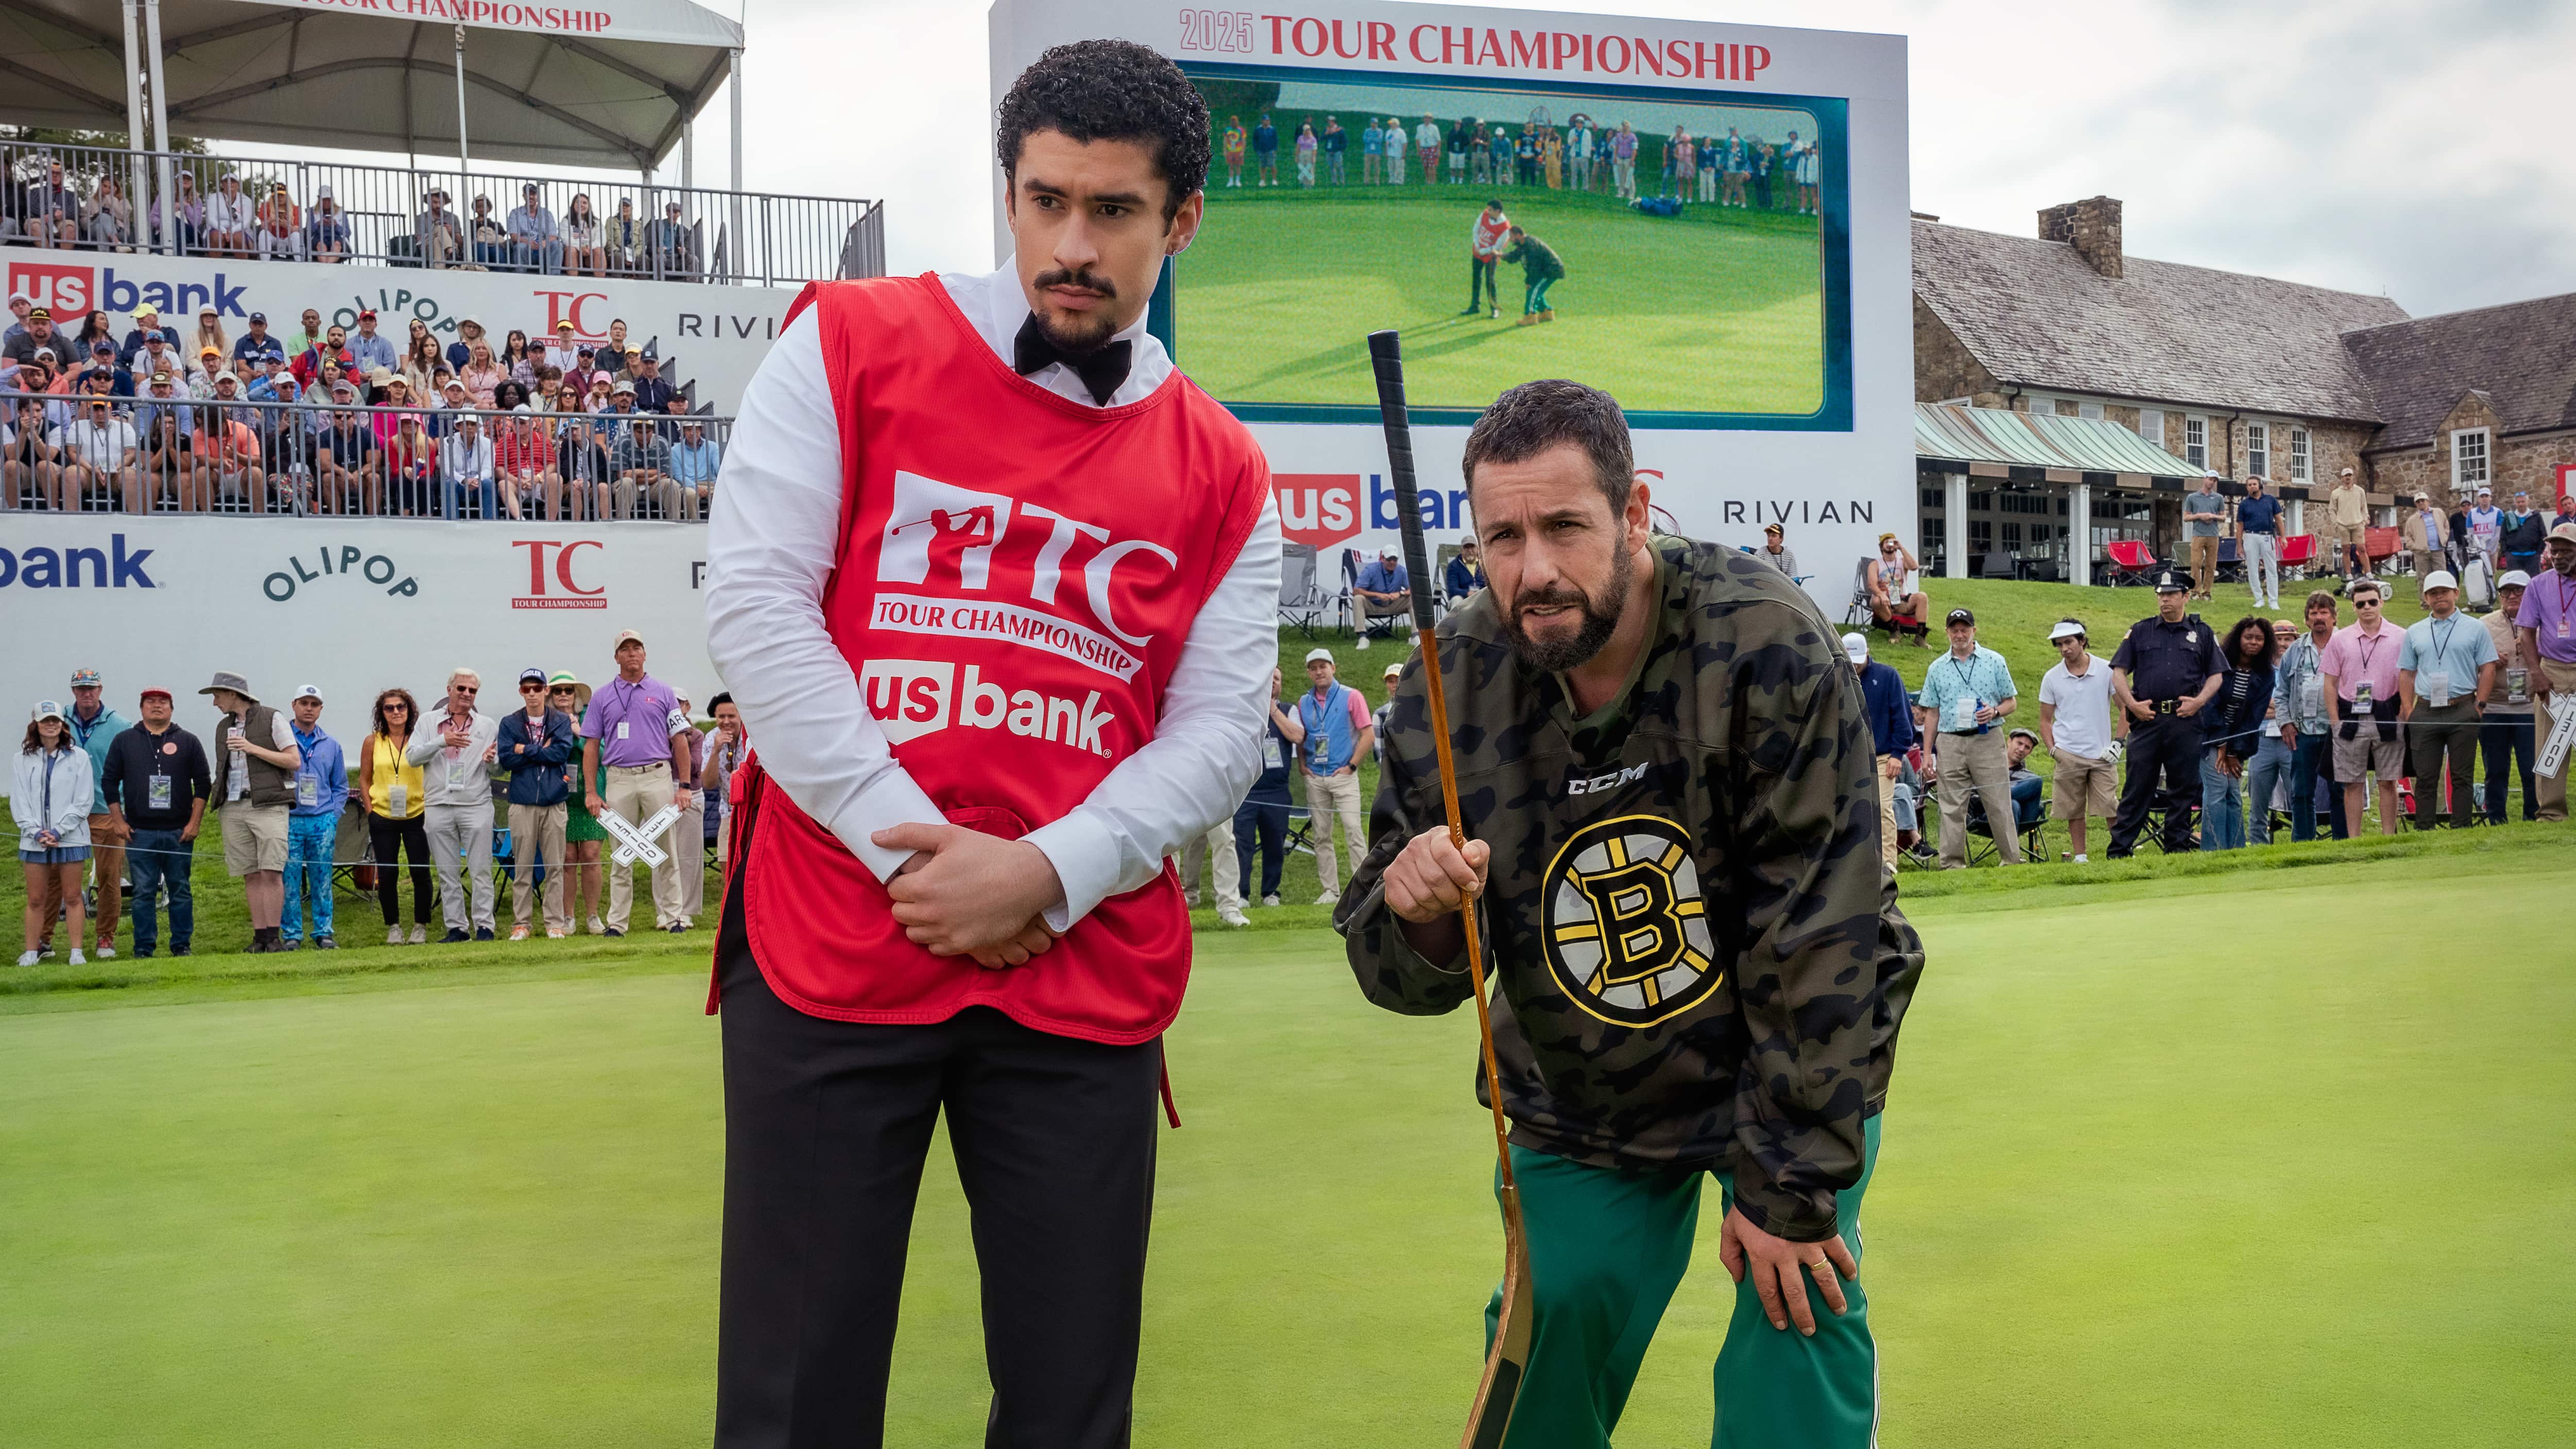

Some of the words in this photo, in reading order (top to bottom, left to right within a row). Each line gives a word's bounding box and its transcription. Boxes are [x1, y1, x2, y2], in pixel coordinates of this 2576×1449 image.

[1179, 9, 1253, 53] 2025
[1261, 15, 1397, 61] TOUR
[1409, 24, 1771, 81] CHAMPIONSHIP
[17, 274, 86, 311] us
[104, 268, 247, 317] bank
[333, 288, 457, 332] OLIPOP
[534, 291, 607, 337] TC
[679, 314, 773, 340] RIVI
[1280, 487, 1353, 531] us
[1724, 501, 1873, 523] RIVIAN
[263, 545, 418, 602] OLIPOP
[512, 540, 604, 595] TC
[1021, 502, 1178, 647] TC
[878, 602, 944, 627] TOUR
[952, 608, 1131, 673] CHAMPIONSHIP
[867, 676, 940, 723] us
[959, 664, 1115, 756] bank
[2545, 711, 2574, 767] QUIET
[1568, 762, 1649, 795] CCM
[614, 822, 657, 858] QUIET
[623, 817, 666, 857] QIET
[1581, 862, 1685, 984] B
